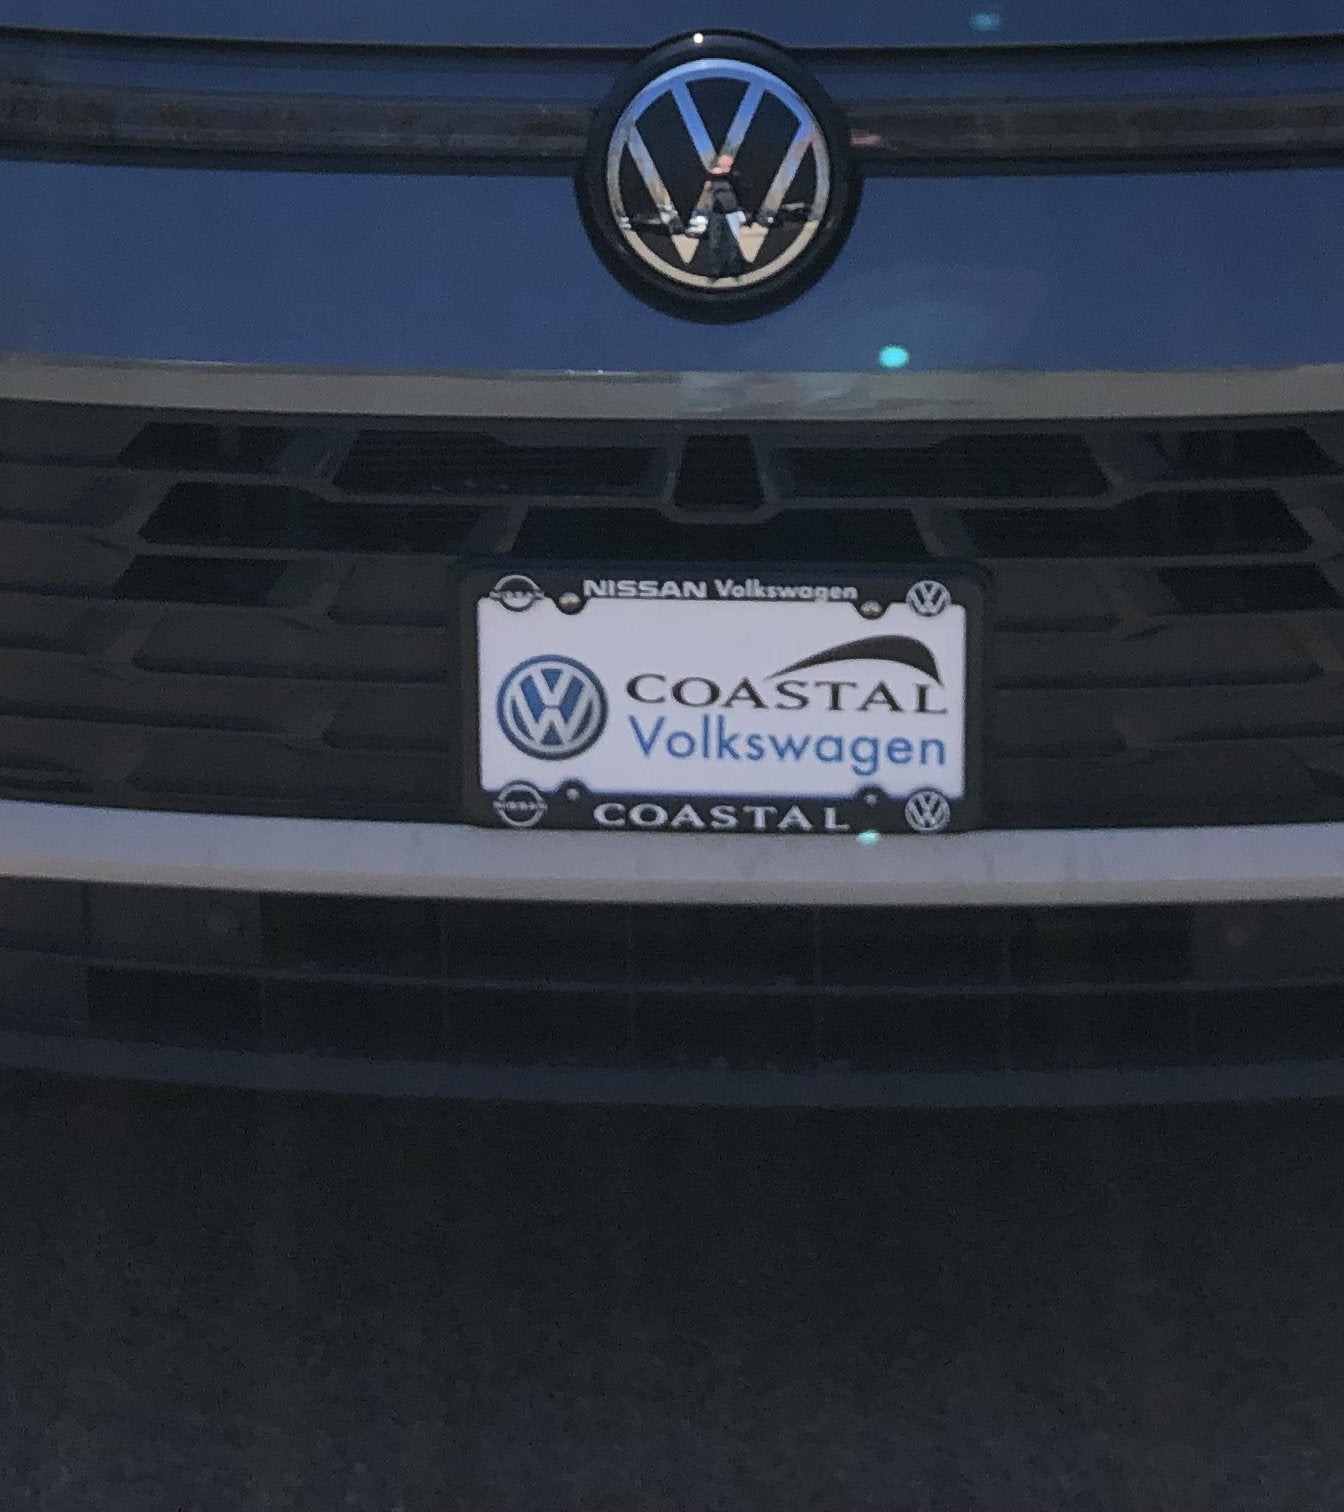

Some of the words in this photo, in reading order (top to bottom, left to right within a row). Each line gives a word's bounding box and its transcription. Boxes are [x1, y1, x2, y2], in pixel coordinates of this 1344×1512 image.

[583, 579, 707, 598] NISSAN
[714, 579, 857, 600] Volkswagen
[626, 673, 948, 714] COASTAL
[629, 714, 946, 776] Volkswagen
[593, 803, 850, 831] COASTAL
